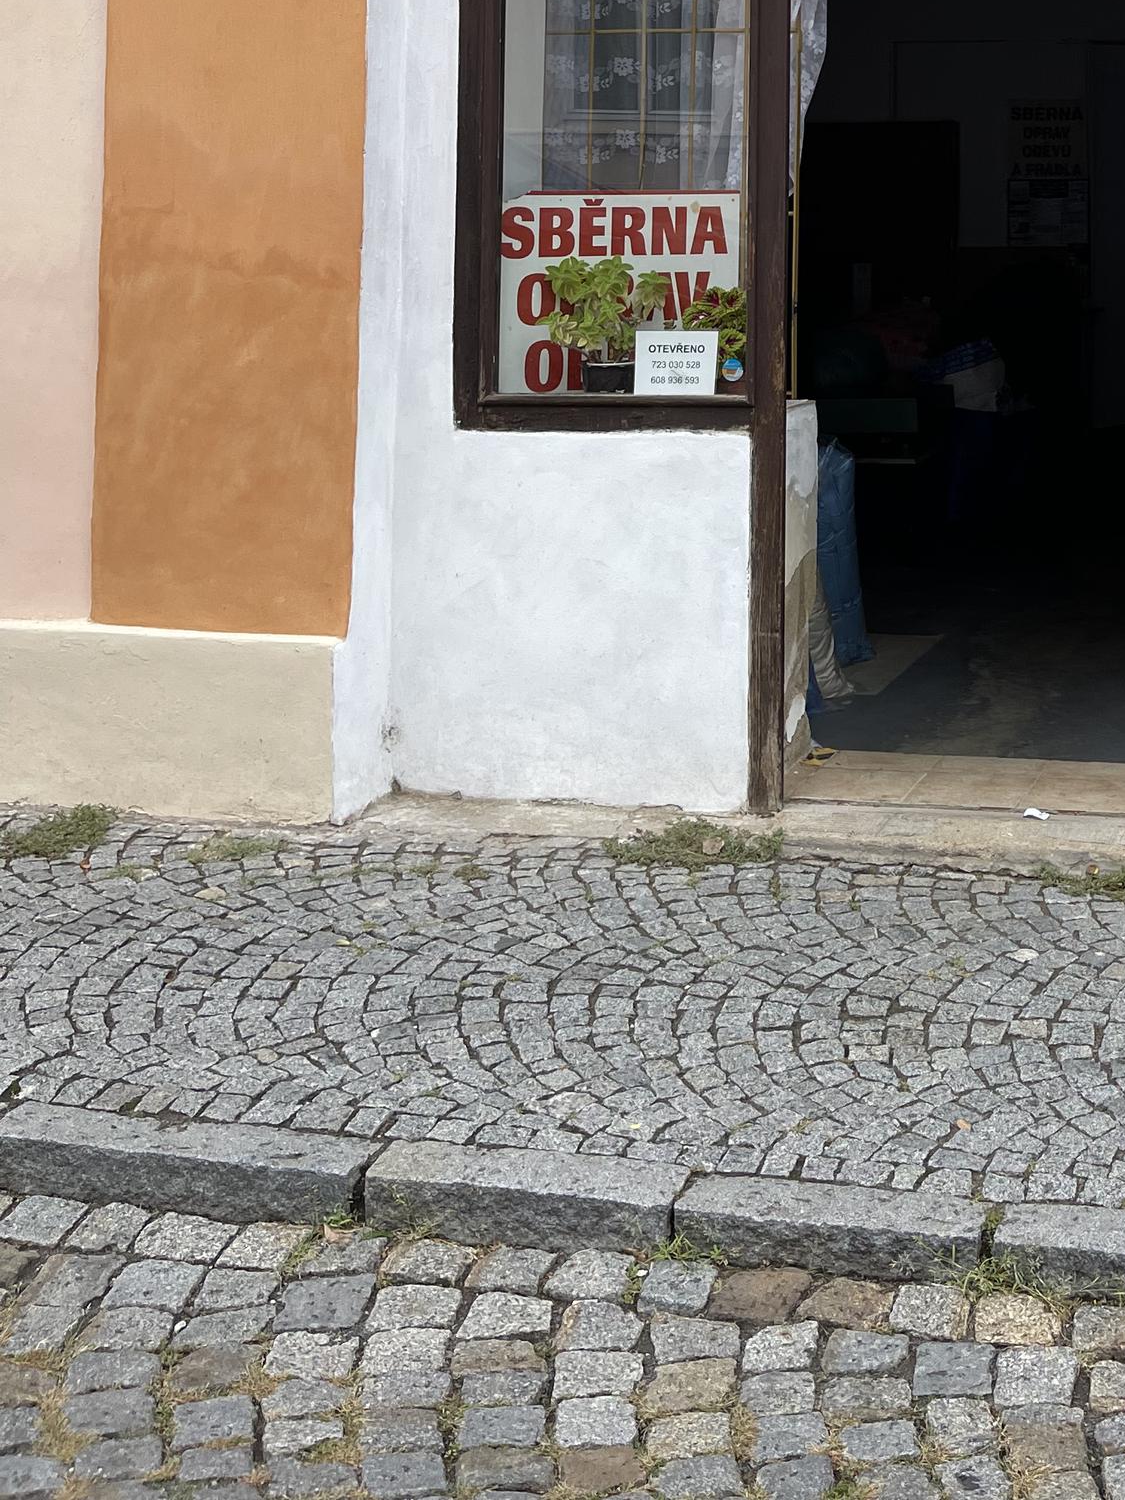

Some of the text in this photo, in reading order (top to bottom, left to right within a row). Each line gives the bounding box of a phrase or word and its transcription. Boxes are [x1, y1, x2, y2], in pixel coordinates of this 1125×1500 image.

[501, 198, 728, 259] SBĚRNA
[517, 271, 710, 326] OAV
[648, 342, 706, 354] OTEVŘENO
[651, 361, 701, 369] 723 030 528
[650, 376, 700, 384] 608 936 593
